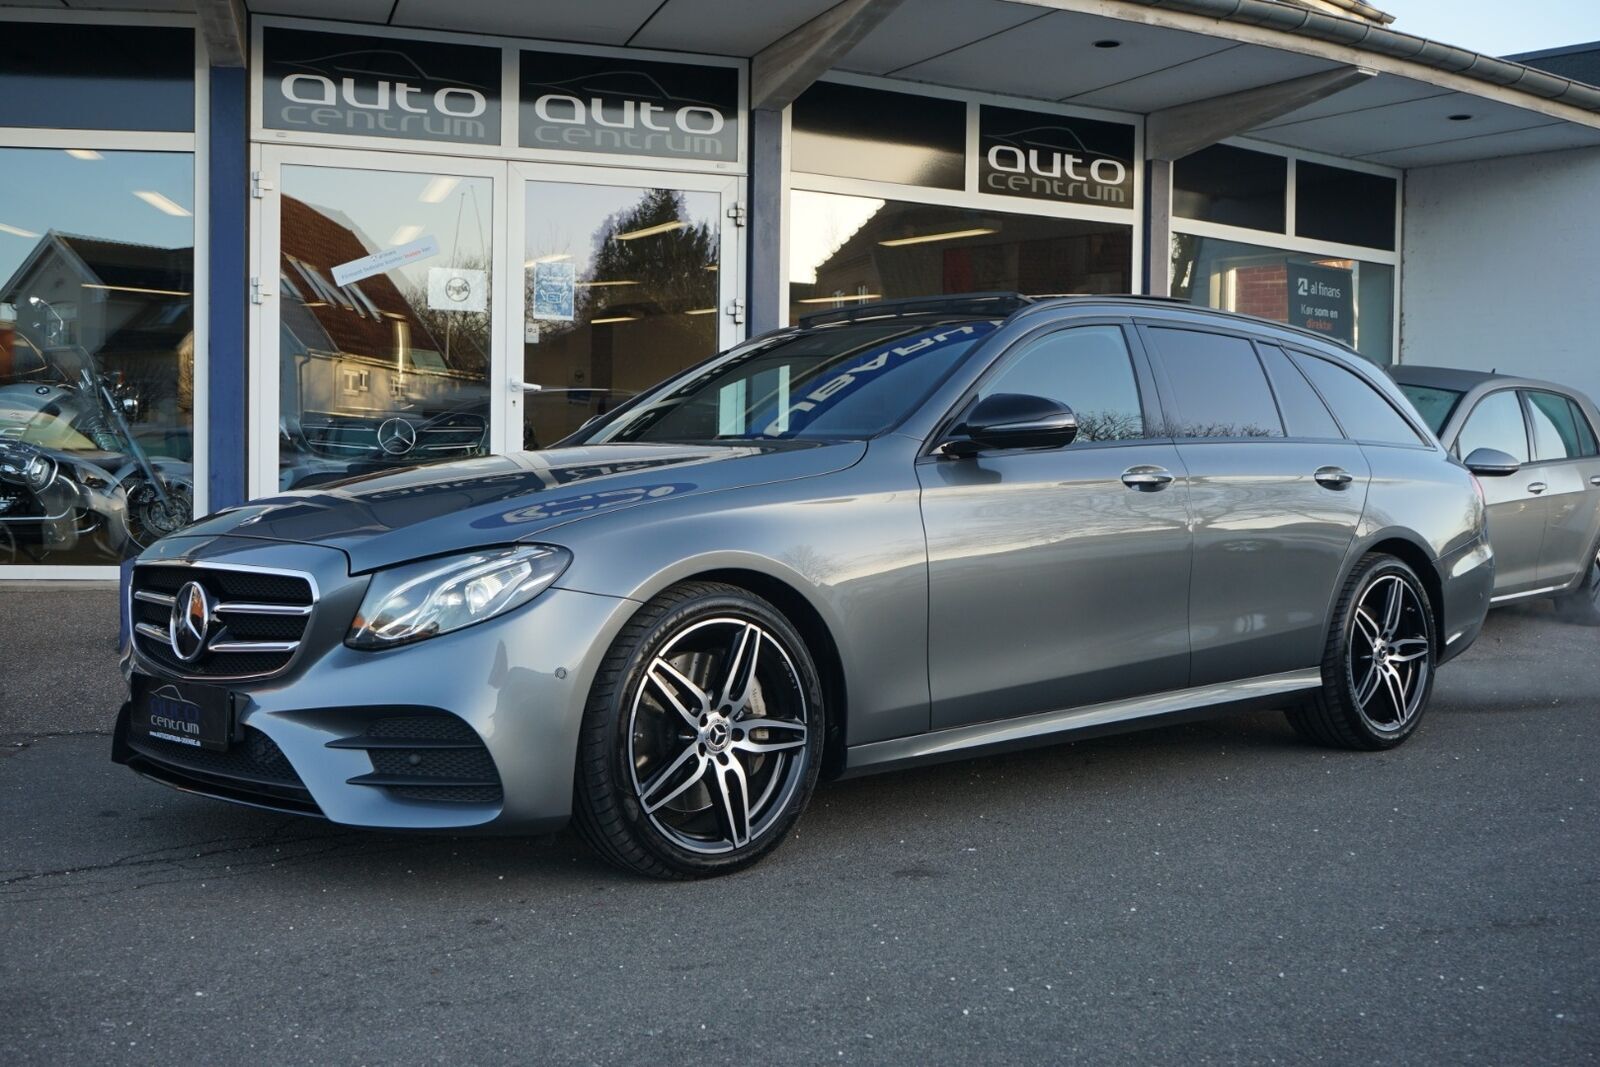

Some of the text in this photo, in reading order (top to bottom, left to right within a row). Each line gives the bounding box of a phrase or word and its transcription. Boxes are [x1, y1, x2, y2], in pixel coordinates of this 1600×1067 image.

[281, 74, 487, 118] auto
[281, 105, 486, 138] centrum
[534, 94, 725, 135] auto
[534, 126, 723, 155] centrum
[987, 145, 1126, 185] auto
[987, 173, 1125, 203] centrum
[1319, 282, 1341, 298] finans
[150, 714, 200, 735] centrum
